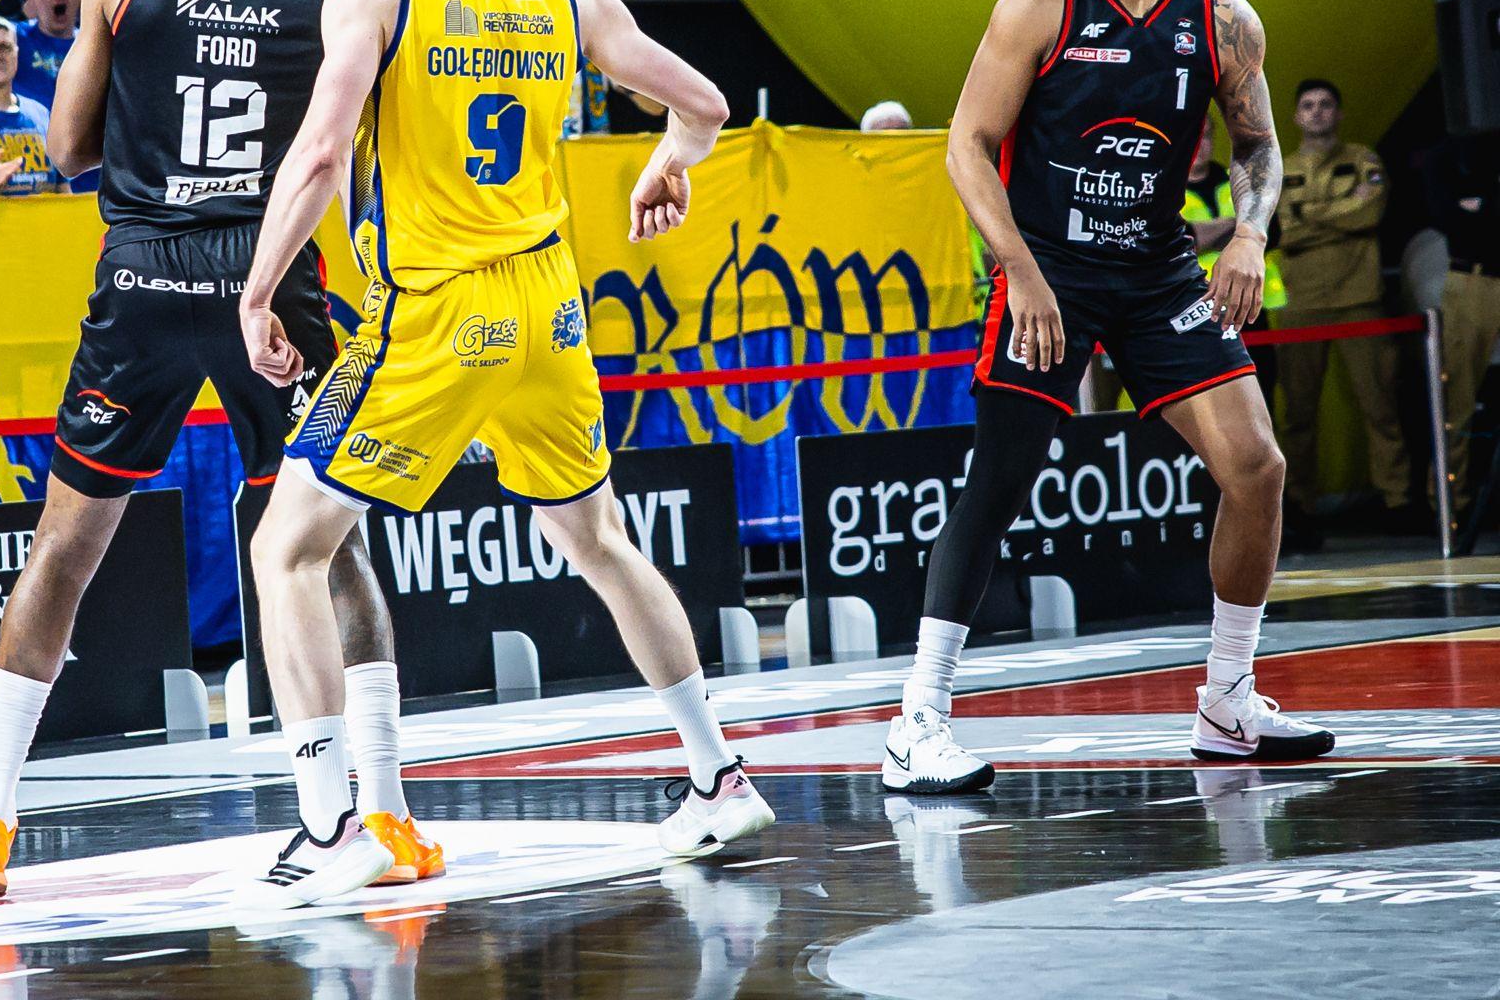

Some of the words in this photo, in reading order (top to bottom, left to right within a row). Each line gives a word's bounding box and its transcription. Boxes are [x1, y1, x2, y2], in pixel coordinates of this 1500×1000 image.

[189, 20, 280, 35] DEVELOPMENT
[483, 21, 553, 35] RENTAL.COM
[196, 34, 257, 67] FORD
[428, 47, 565, 83] GOŁĘBIOWSKI
[1176, 68, 1188, 109] 1
[175, 75, 268, 169] 12
[465, 94, 527, 185] 9
[1095, 135, 1155, 158] PGE
[177, 178, 249, 199] PERŁA
[137, 275, 215, 294] LEXUS
[82, 400, 116, 425] PGE
